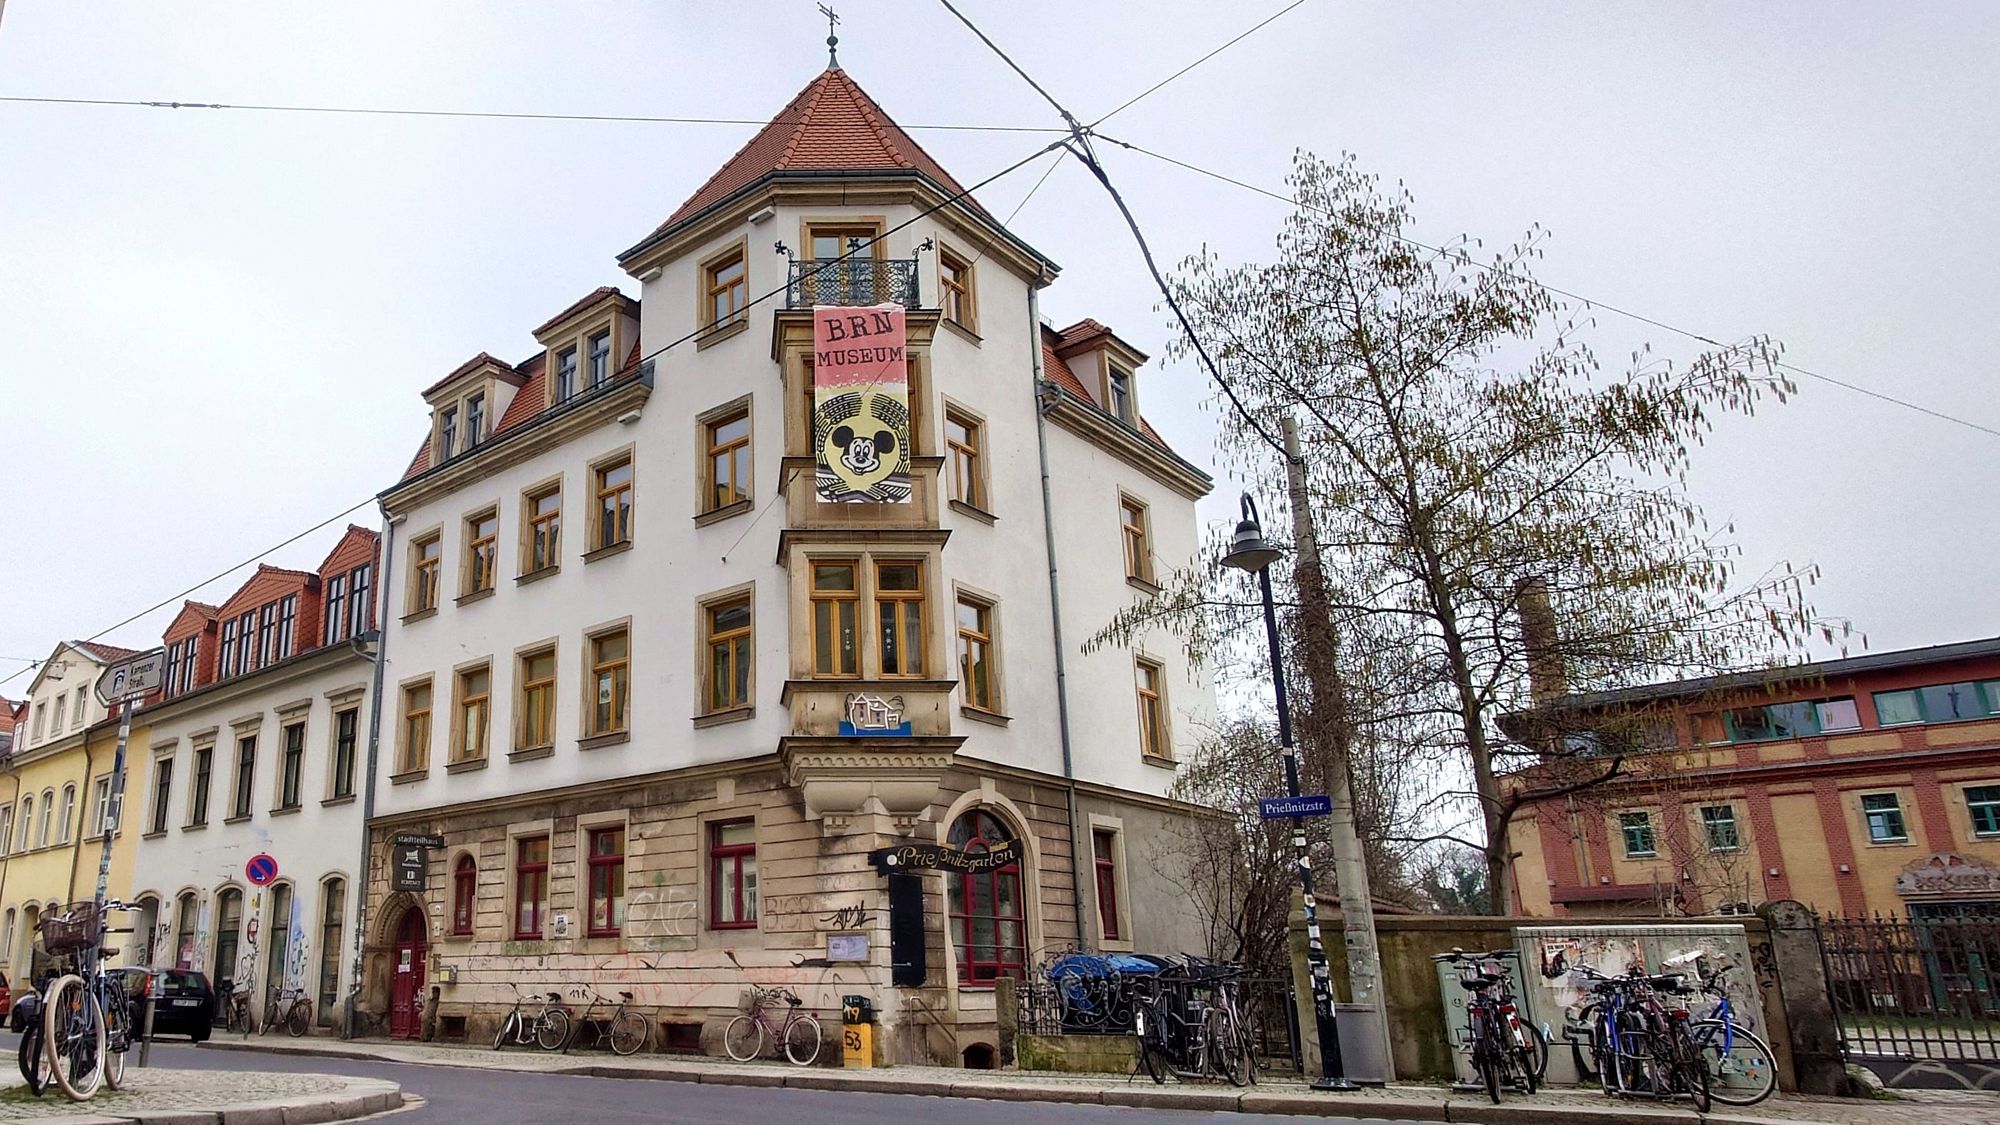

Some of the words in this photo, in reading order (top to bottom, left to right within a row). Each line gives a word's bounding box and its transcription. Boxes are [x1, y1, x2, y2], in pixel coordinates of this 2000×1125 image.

[824, 311, 893, 342] BRN
[817, 346, 904, 367] MUSEUM
[1265, 801, 1327, 814] Prießnitzstr.
[896, 846, 1016, 873] Prießnitzgarten
[844, 1030, 862, 1051] 53
